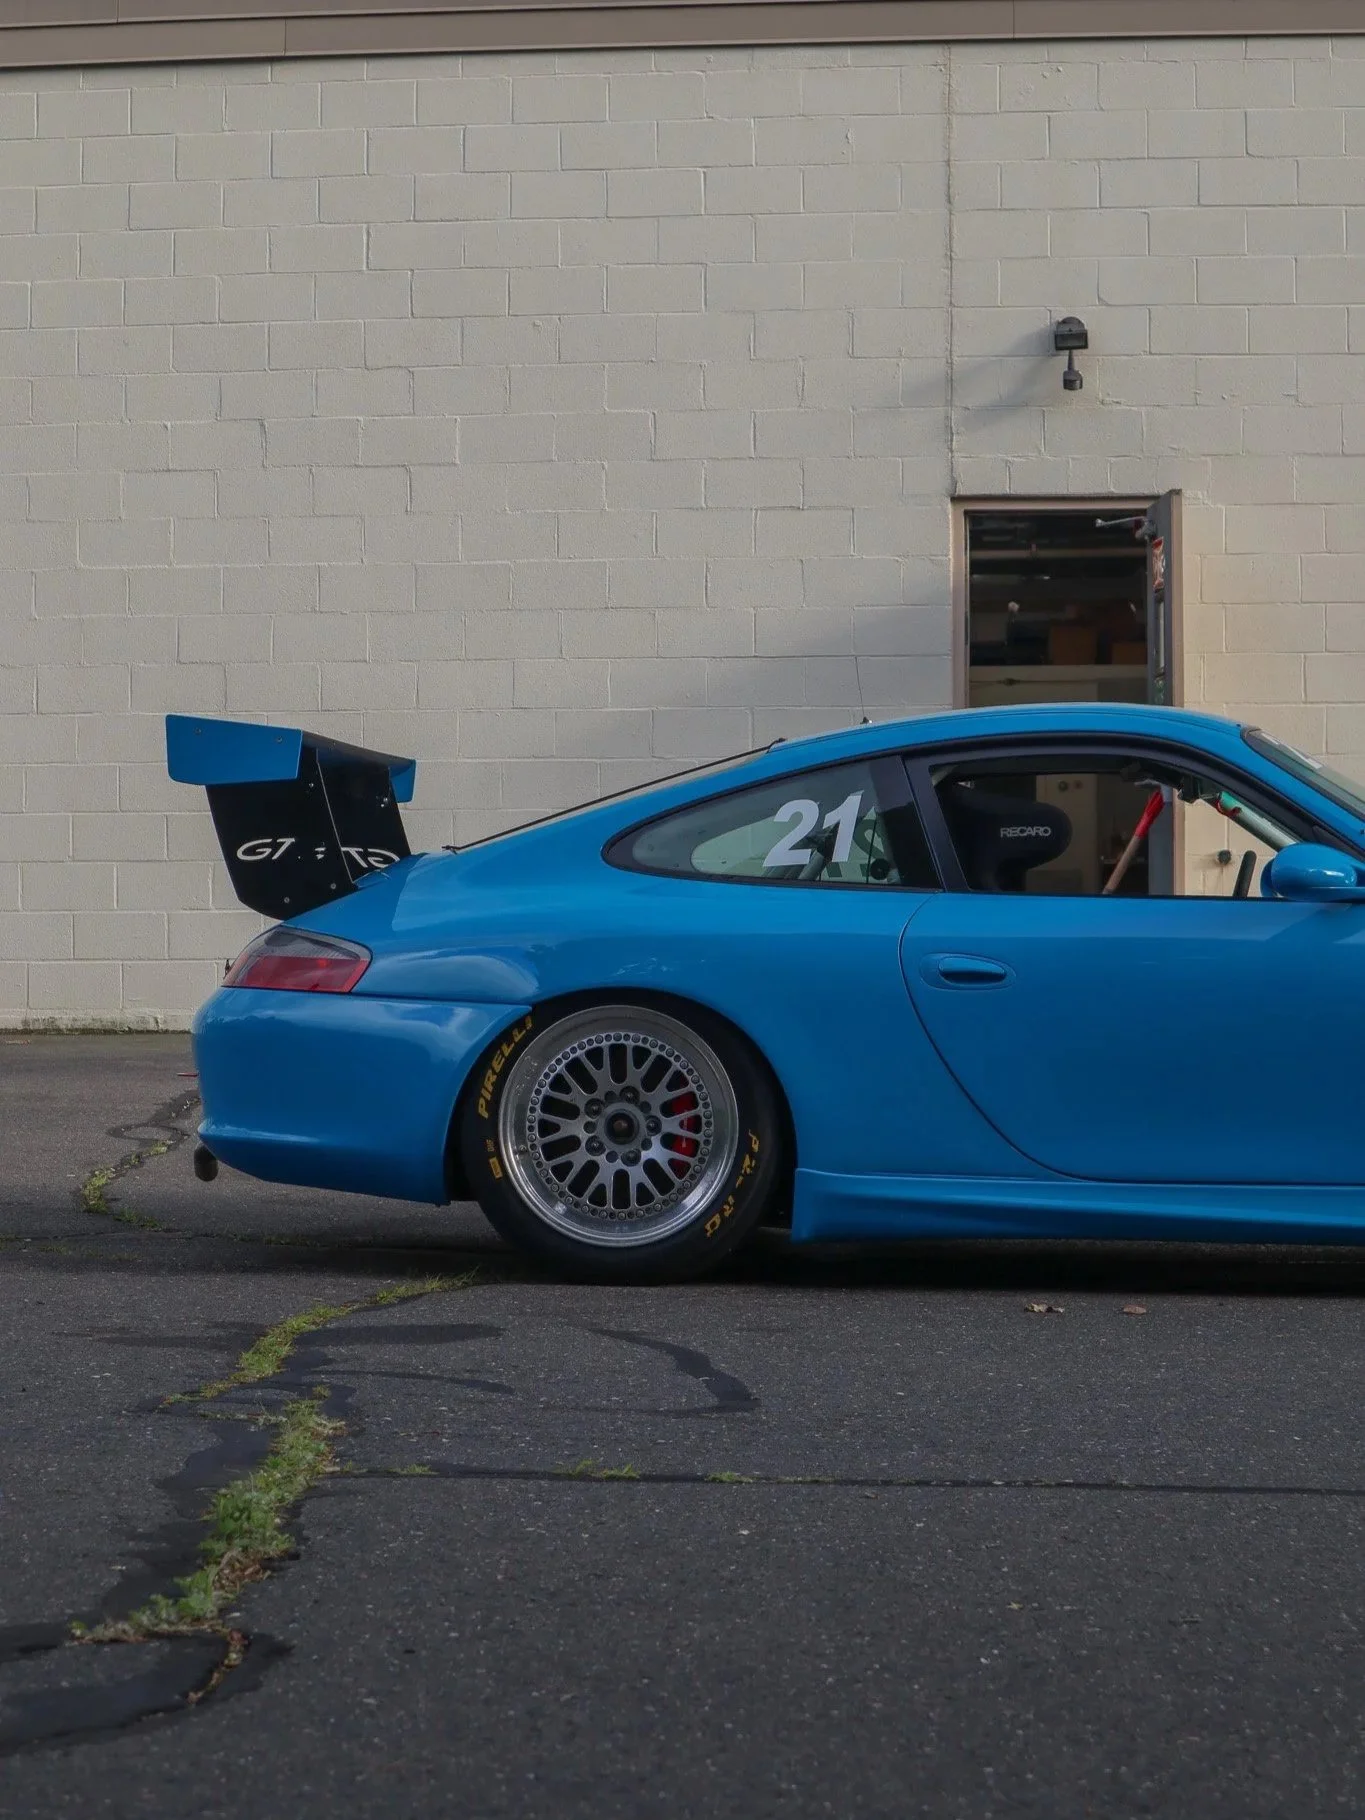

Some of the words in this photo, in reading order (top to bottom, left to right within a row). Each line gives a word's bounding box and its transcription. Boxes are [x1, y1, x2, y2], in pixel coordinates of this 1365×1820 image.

[763, 789, 865, 867] 21
[1000, 826, 1052, 838] RECARO
[477, 1016, 533, 1120] PIRELLI
